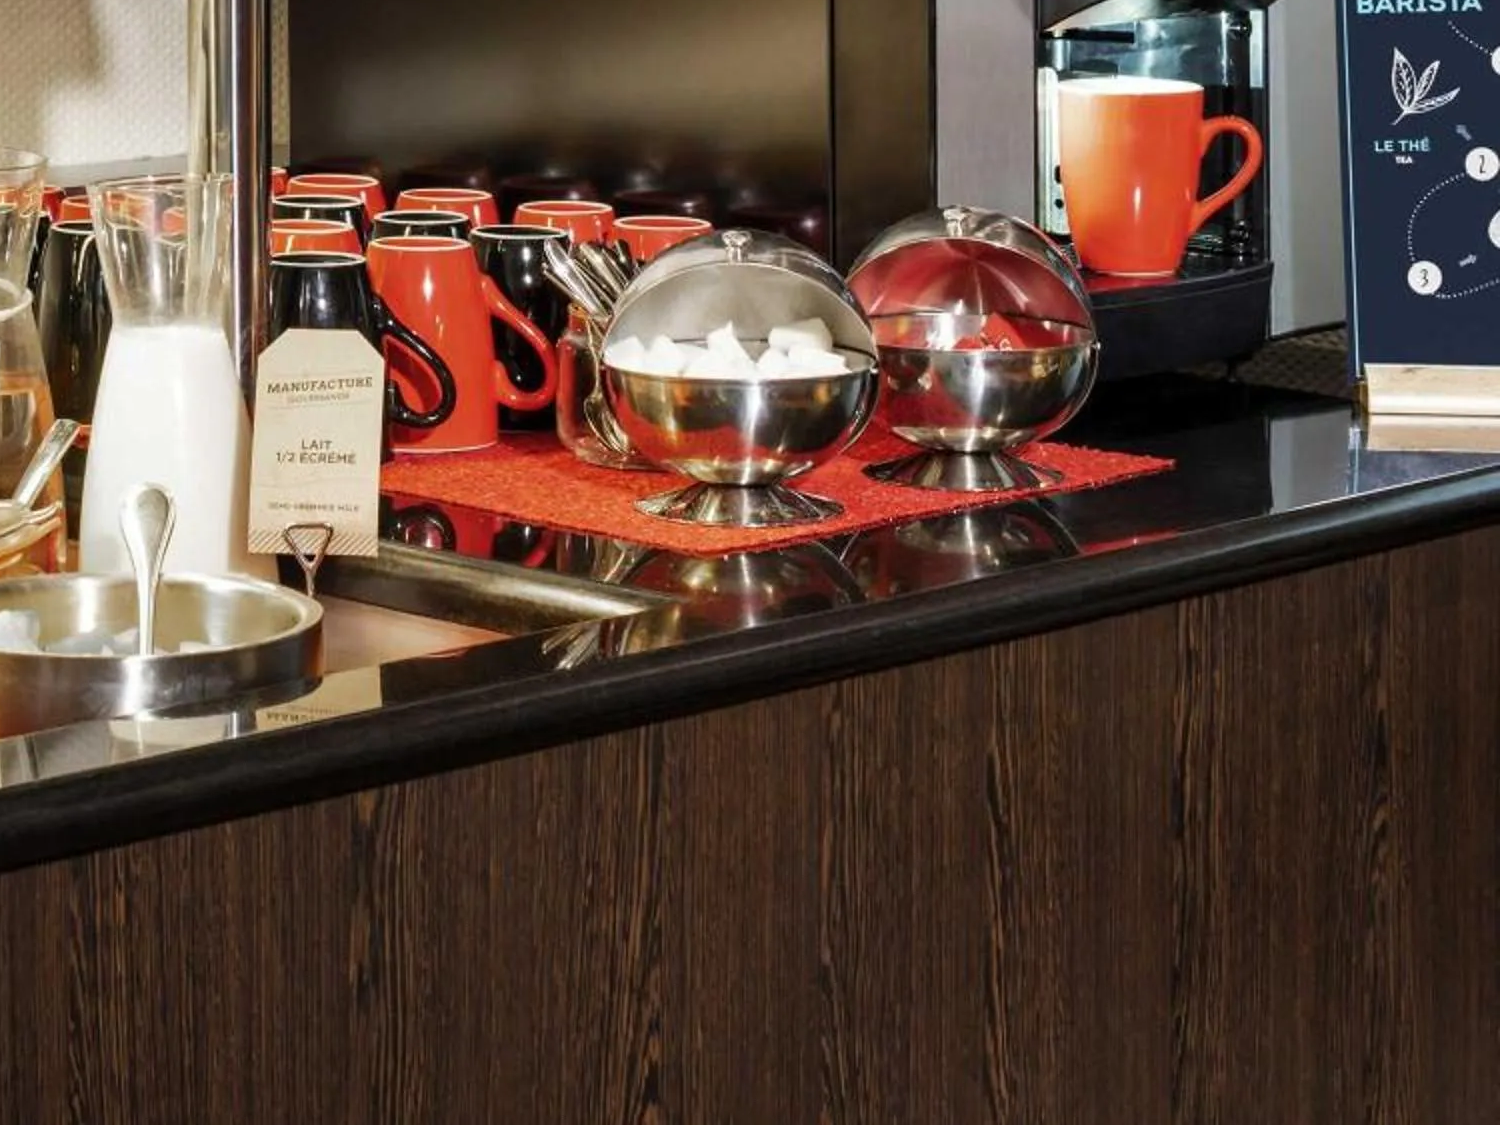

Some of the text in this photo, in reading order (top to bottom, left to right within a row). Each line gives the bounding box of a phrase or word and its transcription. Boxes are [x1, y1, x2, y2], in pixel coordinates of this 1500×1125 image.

[1373, 136, 1430, 152] LE THÉ
[1395, 155, 1414, 164] TEA
[1479, 154, 1486, 174] 2
[1419, 268, 1429, 288] 3
[267, 377, 373, 394] MANUFACTURE
[301, 438, 333, 450] LAIT
[275, 451, 296, 463] 1/2
